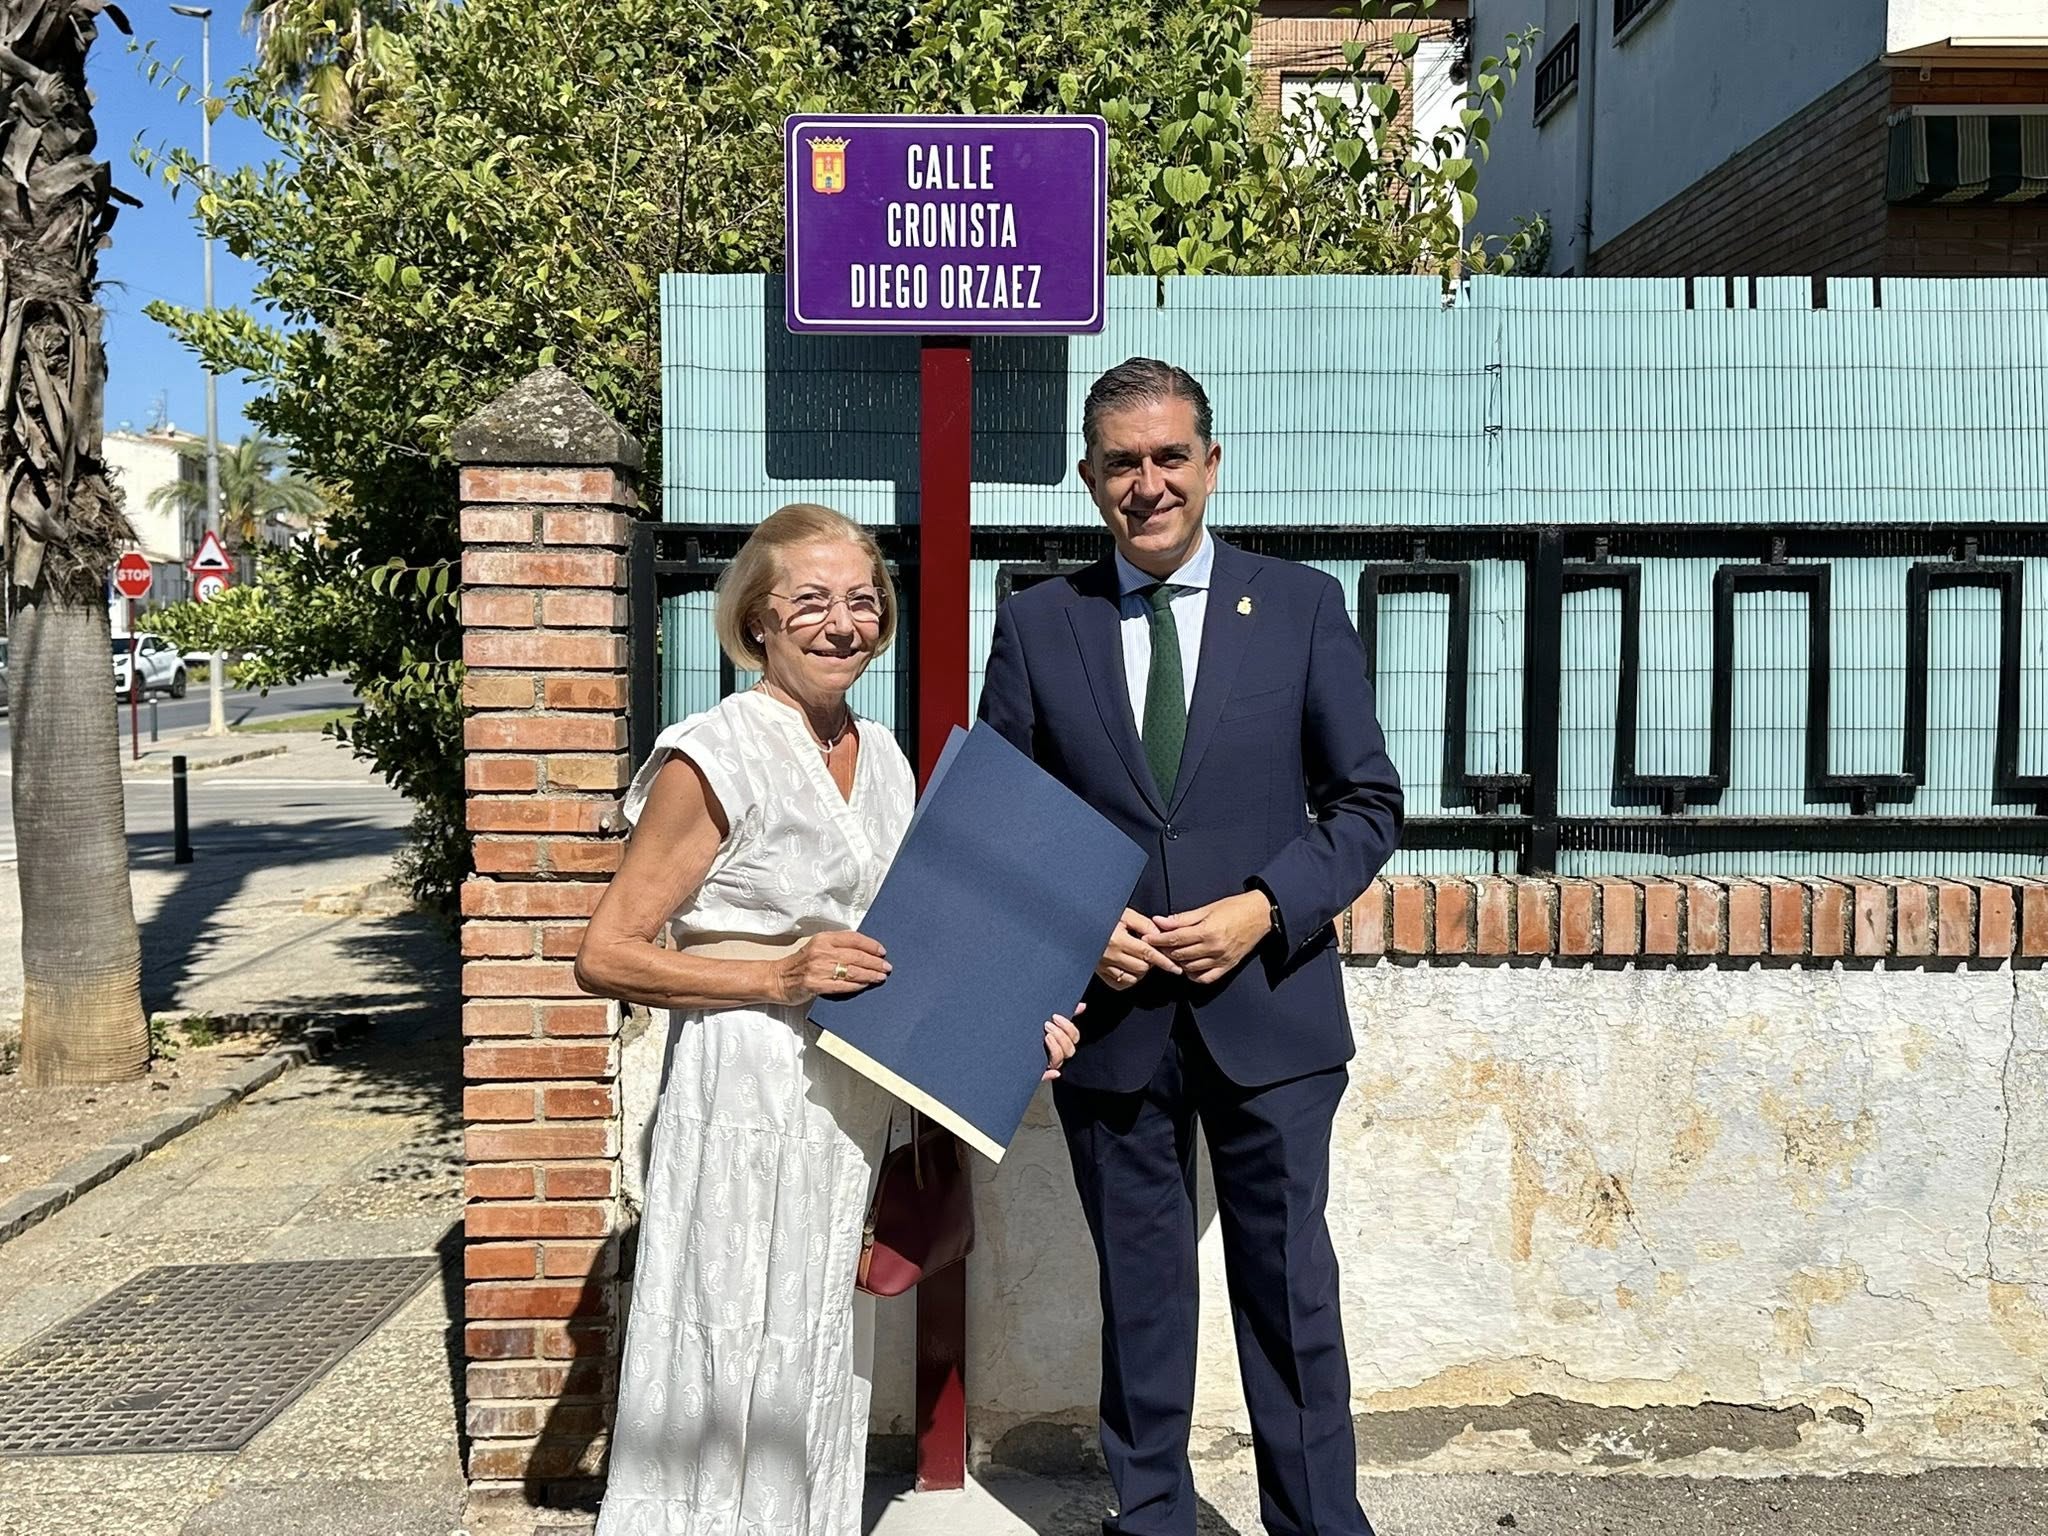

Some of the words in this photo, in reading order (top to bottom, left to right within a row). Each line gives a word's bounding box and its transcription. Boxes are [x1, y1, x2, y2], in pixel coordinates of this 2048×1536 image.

[907, 144, 994, 190] CALLE
[887, 202, 1017, 248] CRONISTA
[851, 264, 928, 309] DIEGO
[940, 264, 1042, 309] ORZAEZ
[118, 568, 150, 581] STOP
[202, 584, 221, 596] 30
